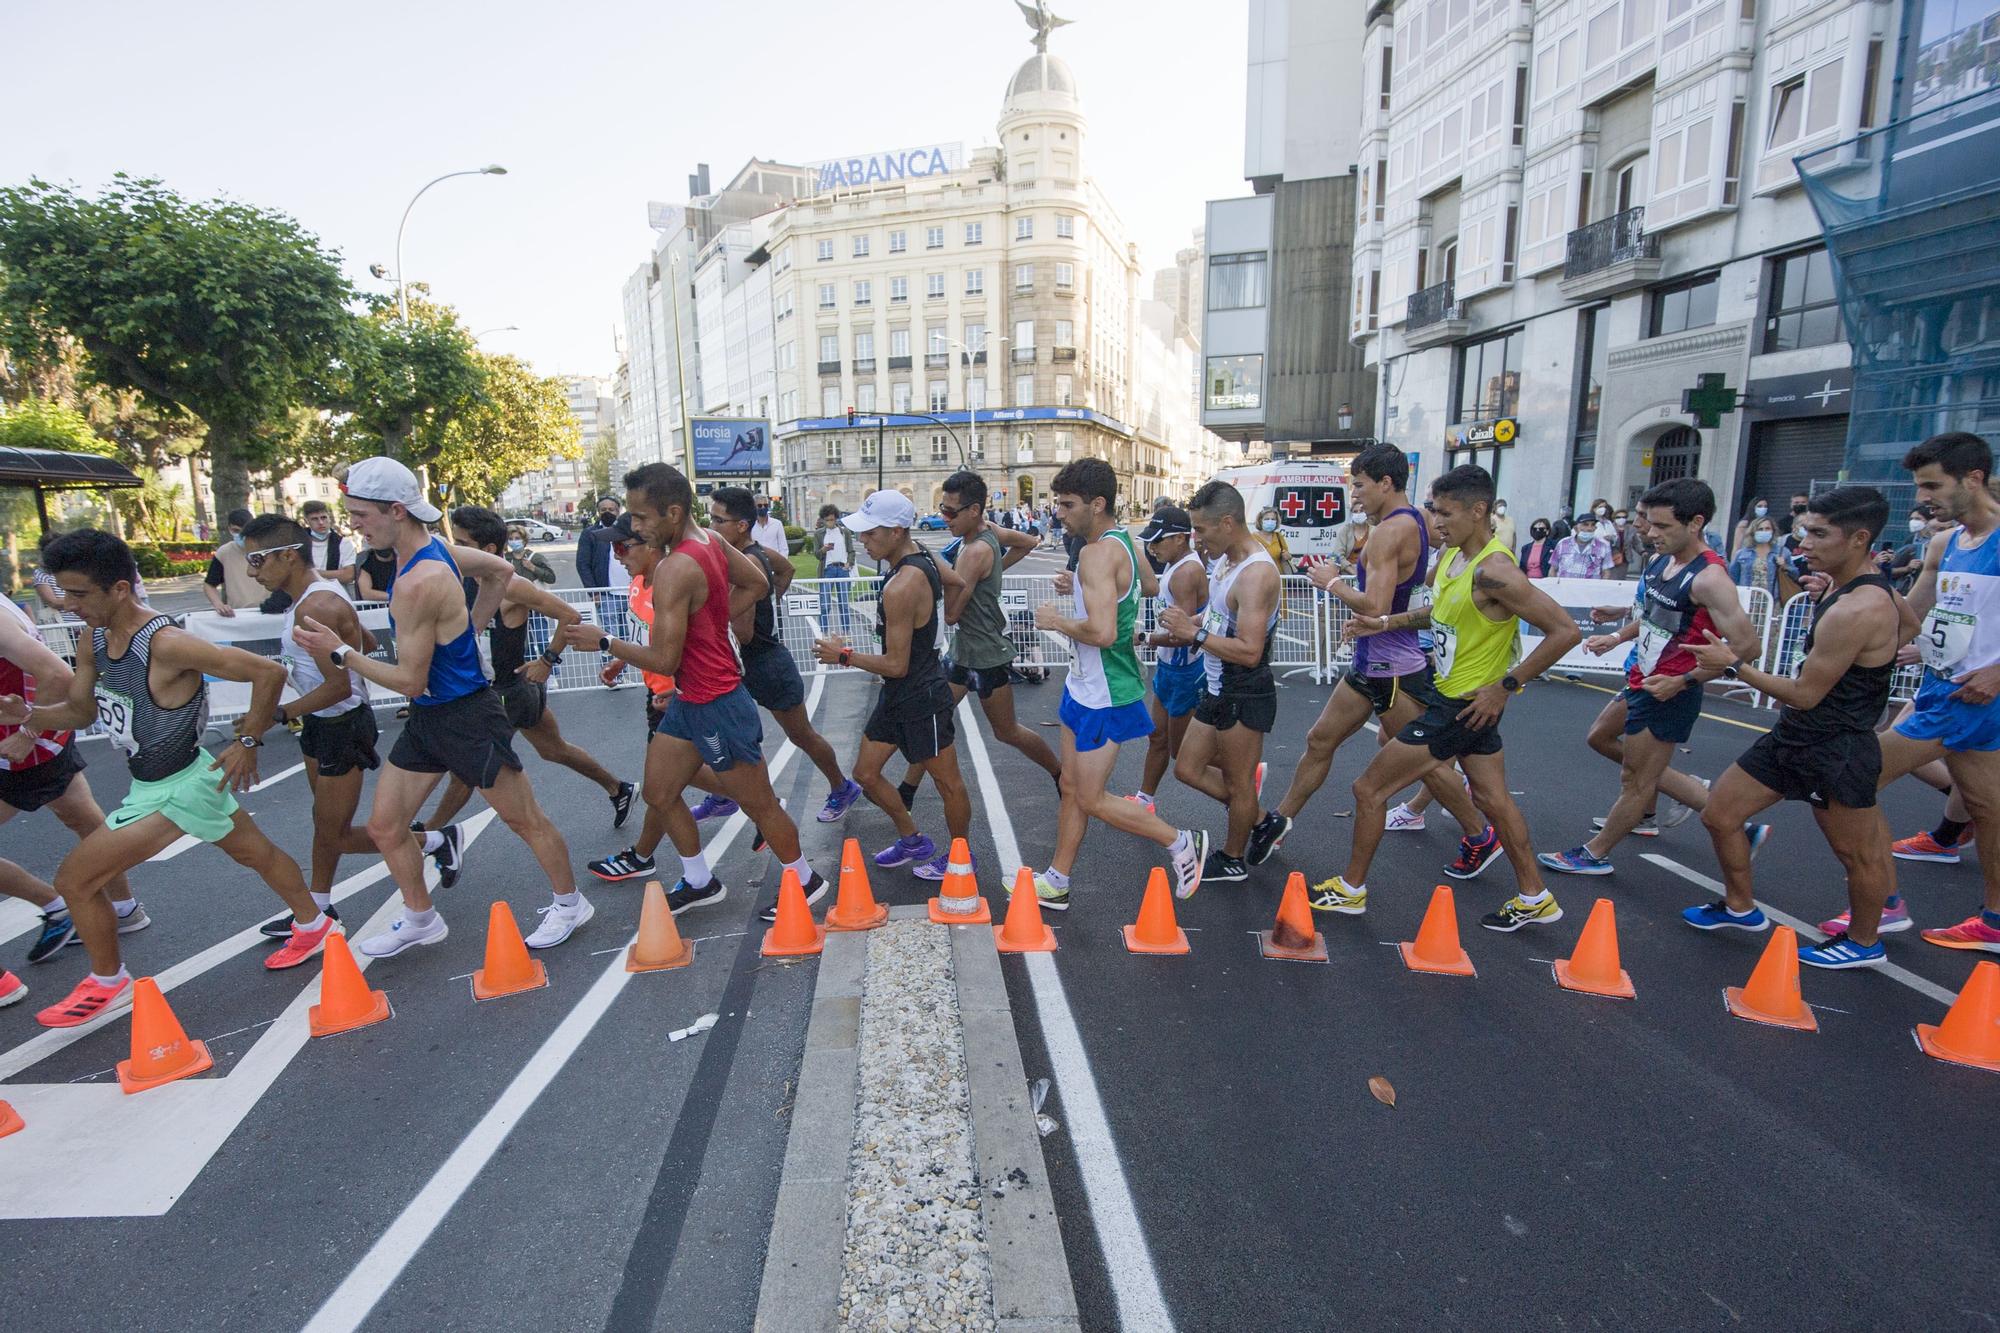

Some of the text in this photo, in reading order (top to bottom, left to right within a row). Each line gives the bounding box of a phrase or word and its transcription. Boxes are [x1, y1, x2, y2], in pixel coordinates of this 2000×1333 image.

[831, 148, 949, 187] ABANCA
[1210, 392, 1259, 405] TEZENIS
[993, 411, 1015, 419] Allianz
[695, 424, 731, 439] dorsia
[1280, 475, 1341, 484] AMBULANCIA
[1320, 529, 1337, 540] Roja
[1931, 619, 1949, 649] 5
[1643, 631, 1651, 654] 4
[96, 696, 125, 734] 69
